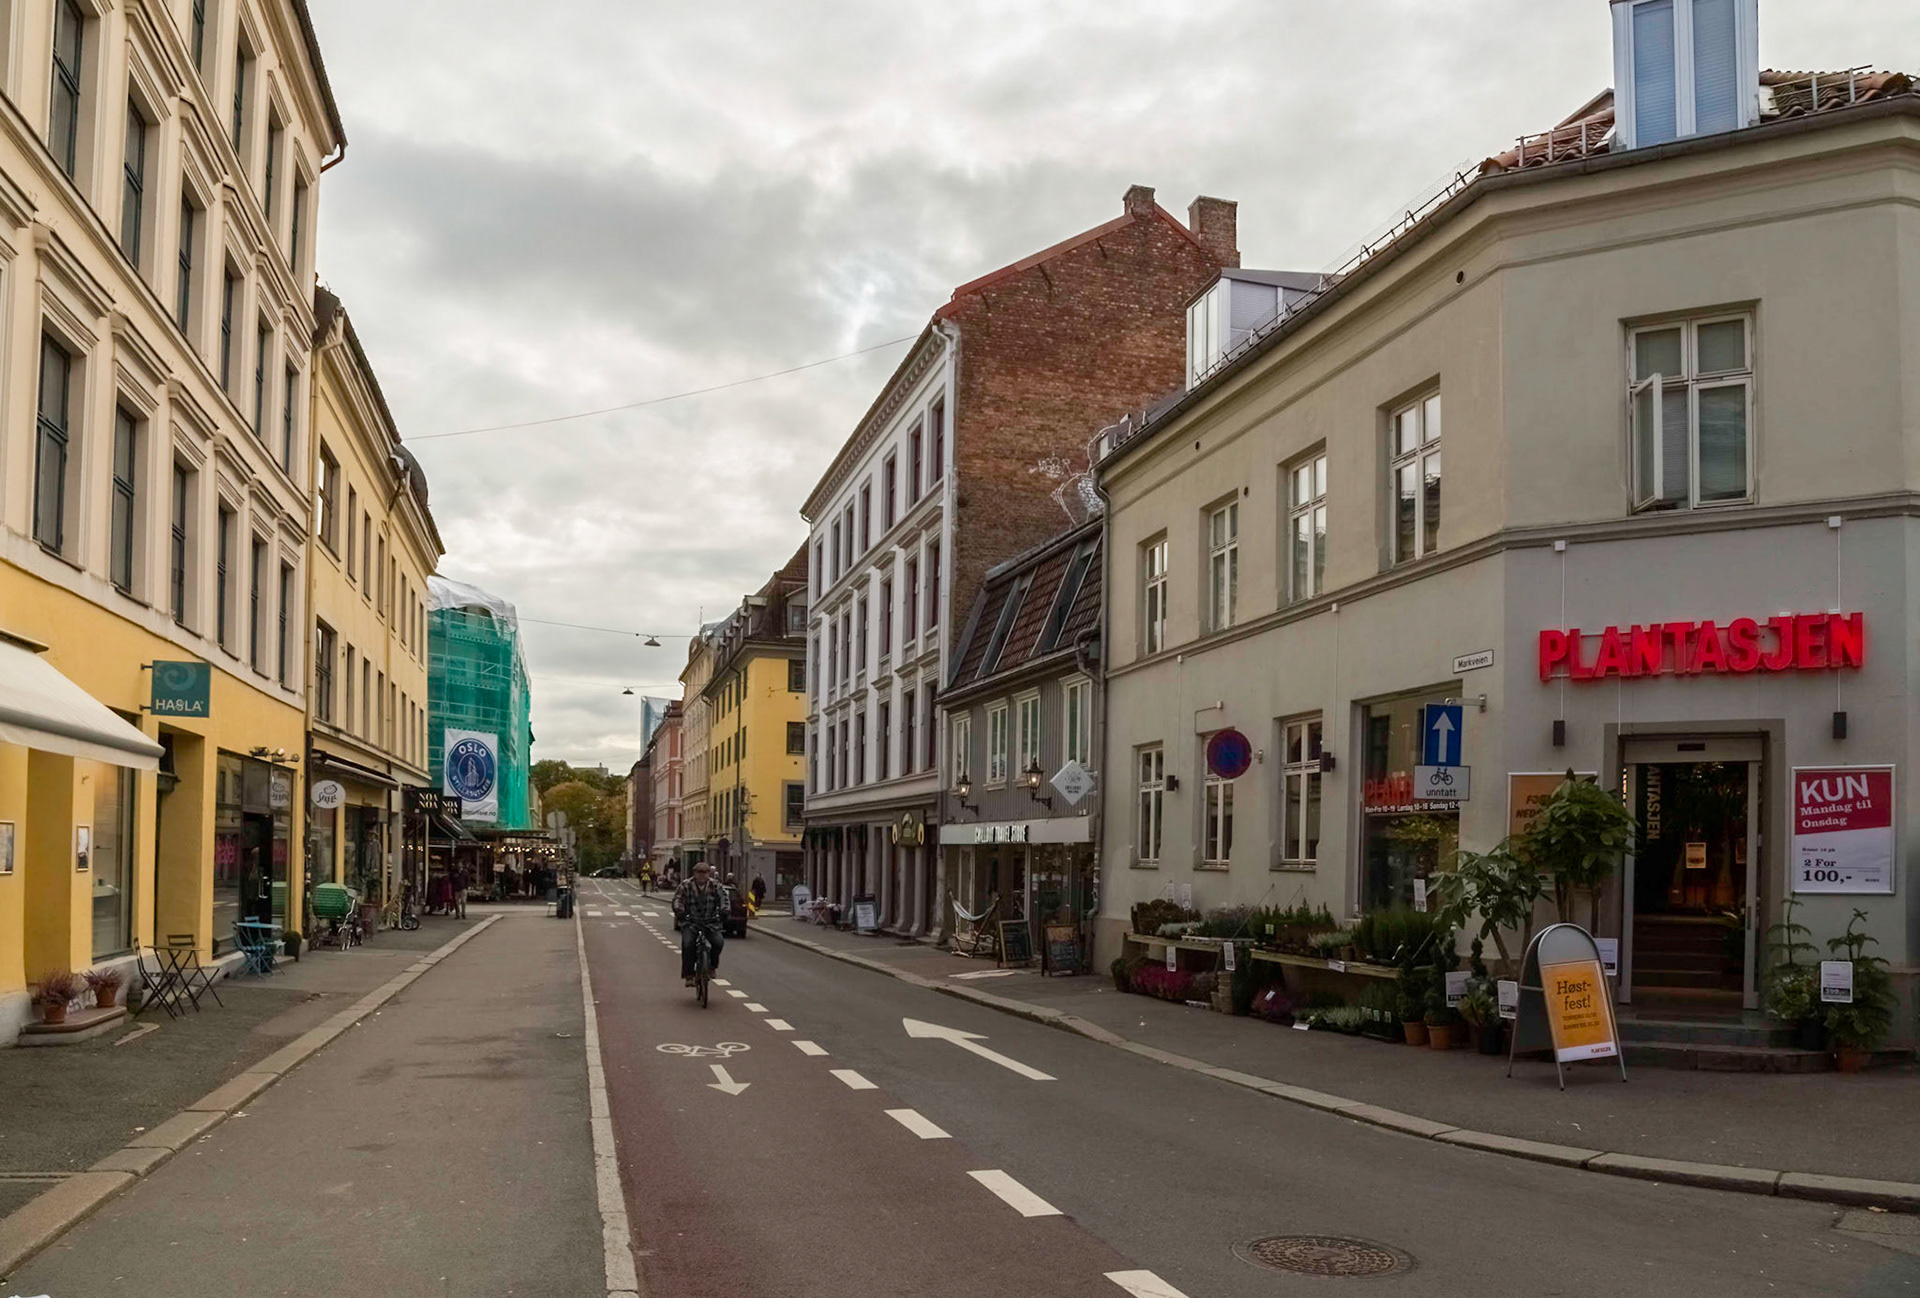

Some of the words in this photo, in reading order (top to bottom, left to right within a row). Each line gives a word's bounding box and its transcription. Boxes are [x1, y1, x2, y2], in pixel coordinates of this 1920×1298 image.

[1539, 612, 1863, 681] PLANTASJEN
[1457, 656, 1489, 668] Markveien
[458, 742, 487, 757] OSLO
[1425, 788, 1457, 797] unntatt
[1800, 774, 1870, 804] KUN
[1646, 765, 1662, 840] ANTASJEN
[1800, 803, 1853, 816] Mandag
[1856, 800, 1872, 809] til
[1801, 817, 1848, 828] Onsdag
[1804, 859, 1812, 867] 2
[1815, 859, 1837, 867] For
[1803, 869, 1852, 884] 100,-
[1556, 980, 1592, 995] Høst-
[1564, 995, 1591, 1010] fest!
